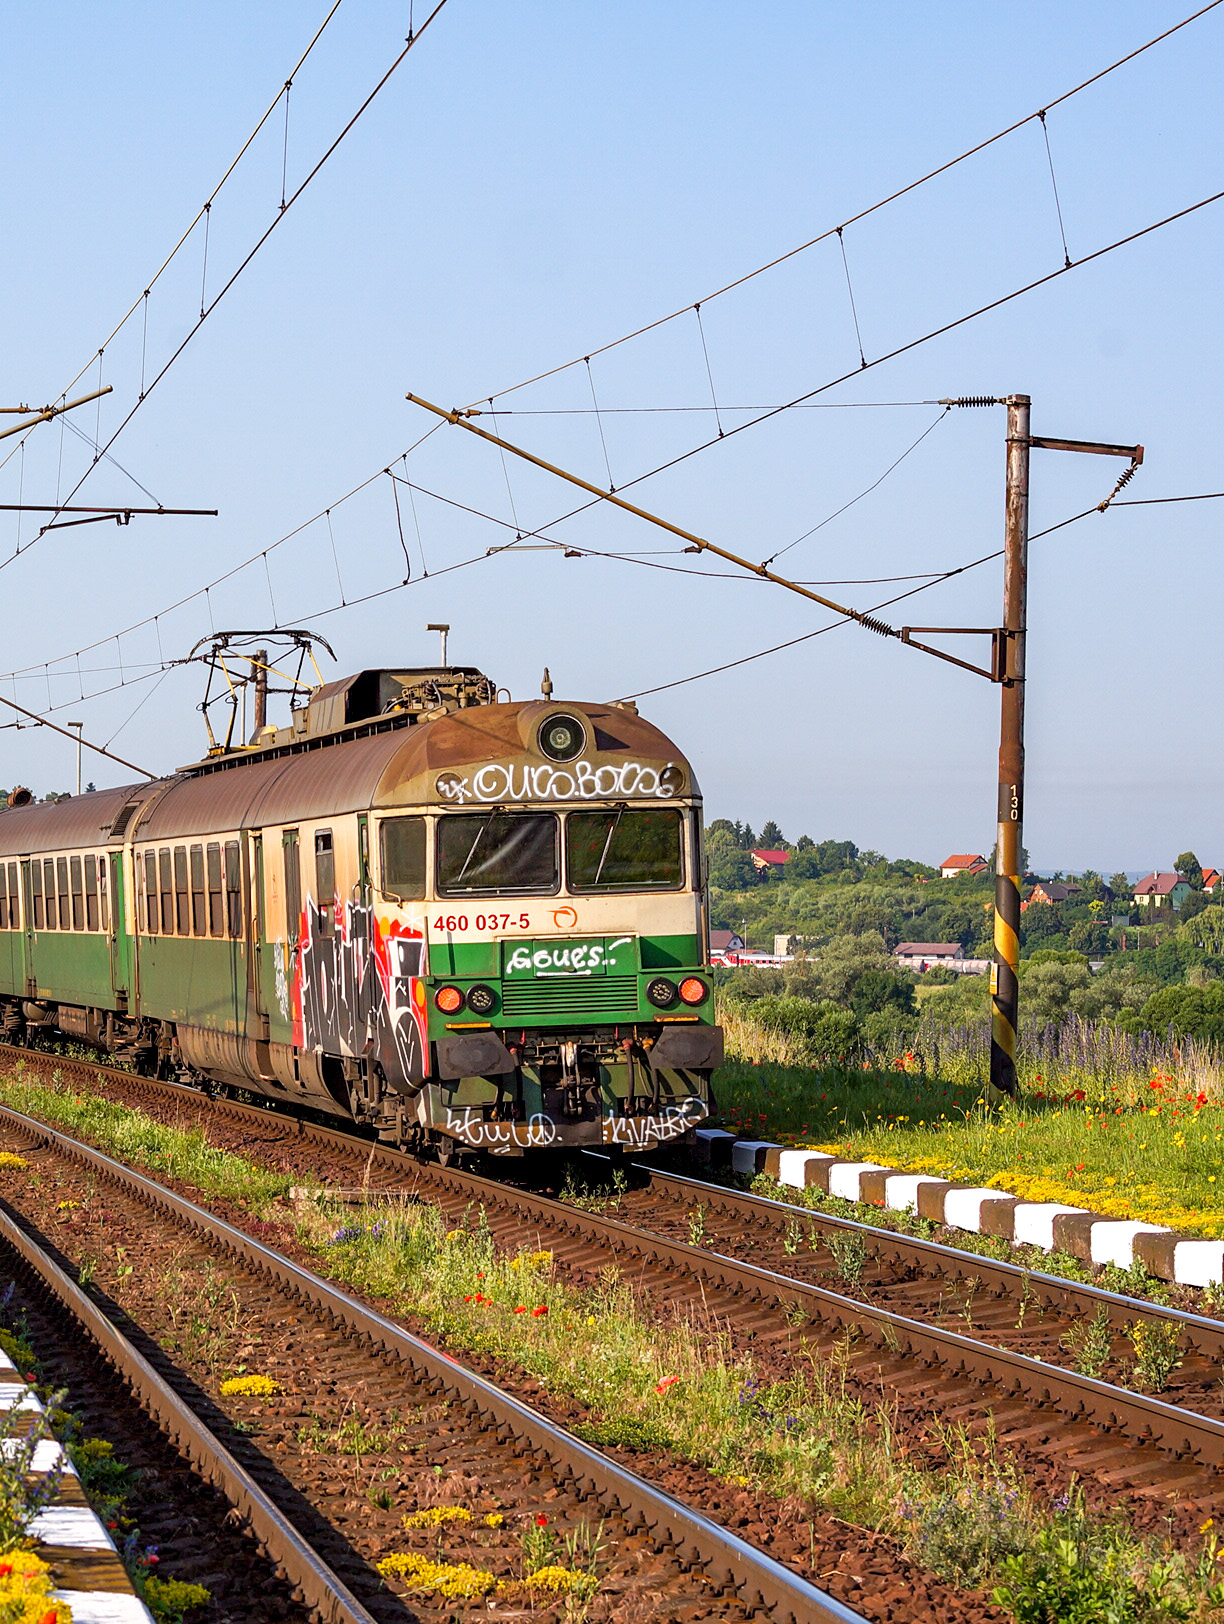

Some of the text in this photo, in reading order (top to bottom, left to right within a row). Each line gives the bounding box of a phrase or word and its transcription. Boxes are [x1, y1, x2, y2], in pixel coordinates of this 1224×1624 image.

[1010, 784, 1019, 821] 130
[433, 912, 531, 932] 460 037-5
